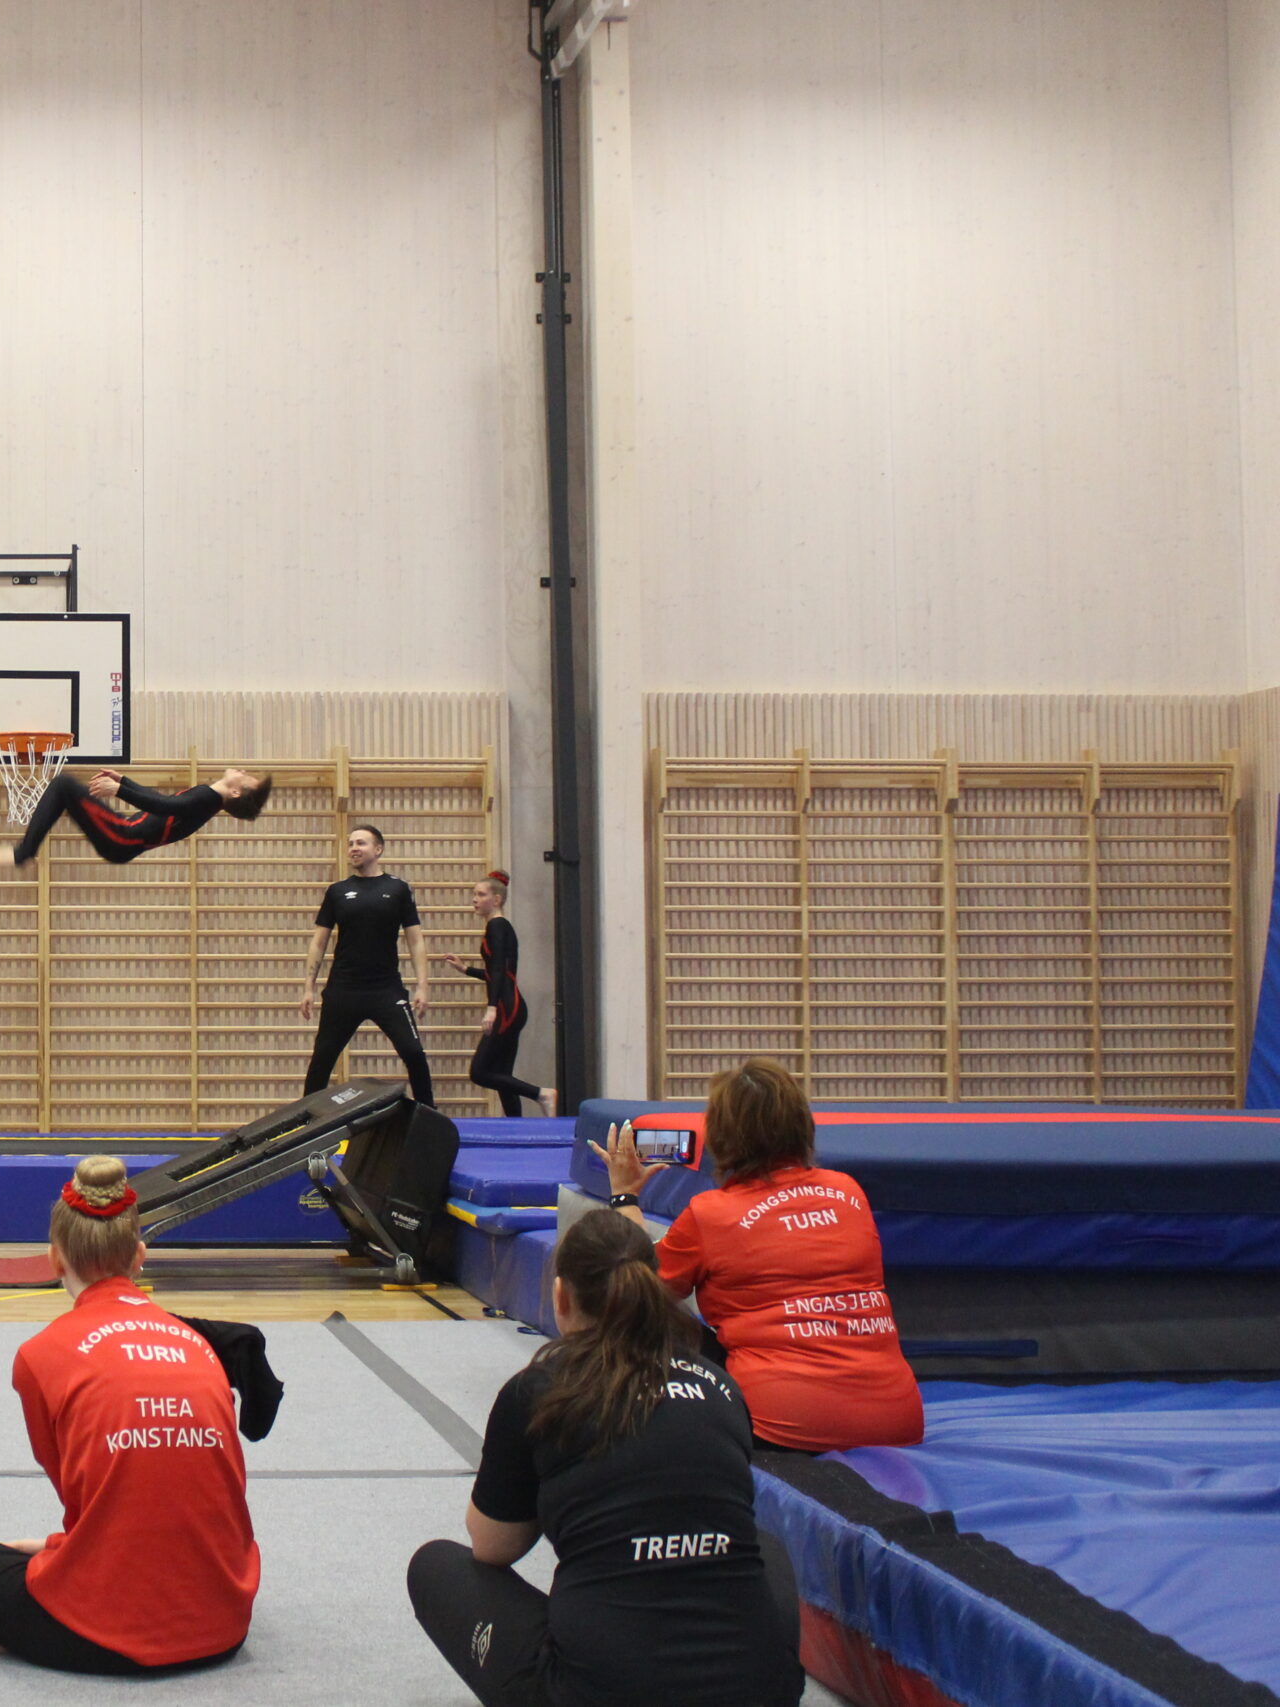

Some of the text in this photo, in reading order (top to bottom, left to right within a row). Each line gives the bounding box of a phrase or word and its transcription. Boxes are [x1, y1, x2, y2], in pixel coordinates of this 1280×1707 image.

[739, 1185, 862, 1230] KONGSVINGER IL
[778, 1208, 839, 1231] TURN
[783, 1291, 887, 1315] ENGASJERT
[77, 1320, 203, 1355] KONGSVINGER
[784, 1316, 897, 1339] TURN MAMMA
[120, 1343, 187, 1364] TURN
[135, 1397, 195, 1418] THEA
[631, 1532, 731, 1561] TRENER
